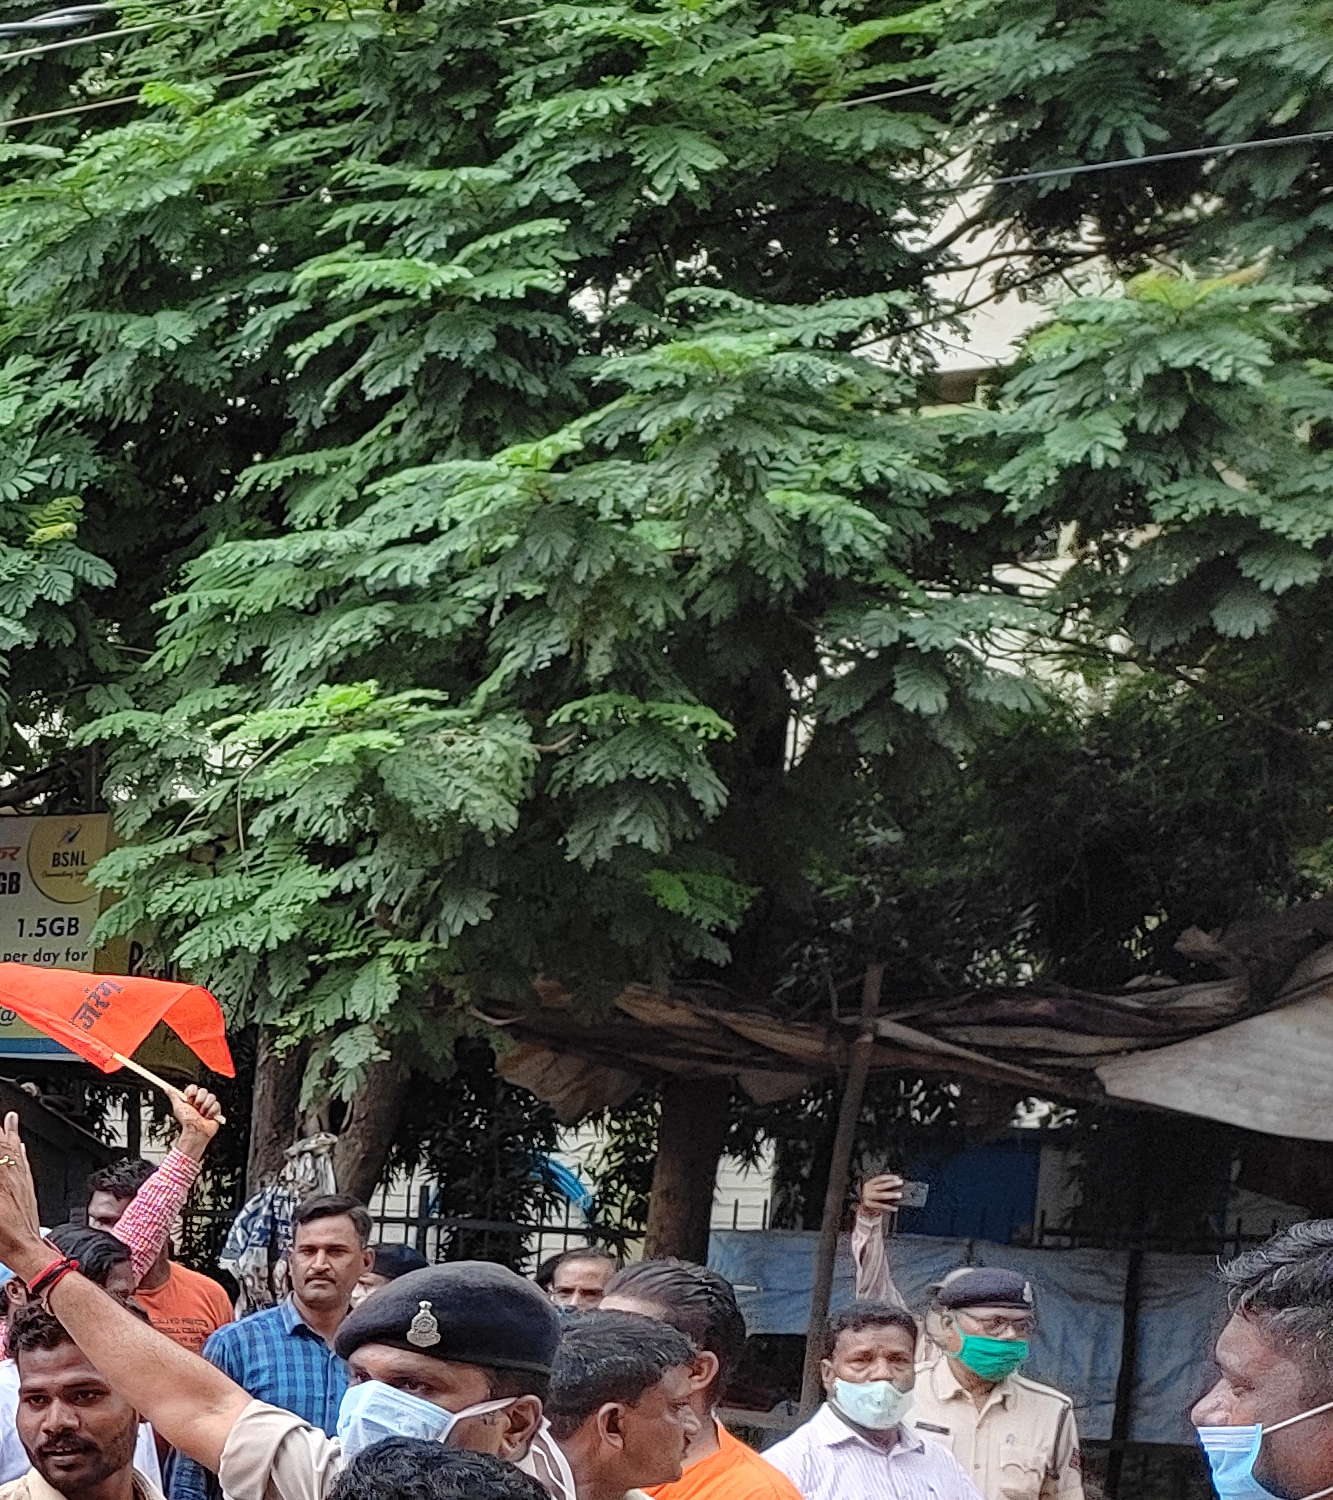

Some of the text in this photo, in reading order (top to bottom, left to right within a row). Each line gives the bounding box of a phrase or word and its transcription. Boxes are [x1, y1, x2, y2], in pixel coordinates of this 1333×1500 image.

[52, 850, 87, 867] BSNL
[17, 917, 80, 938] 1.5GB
[3, 949, 88, 964] per day for
